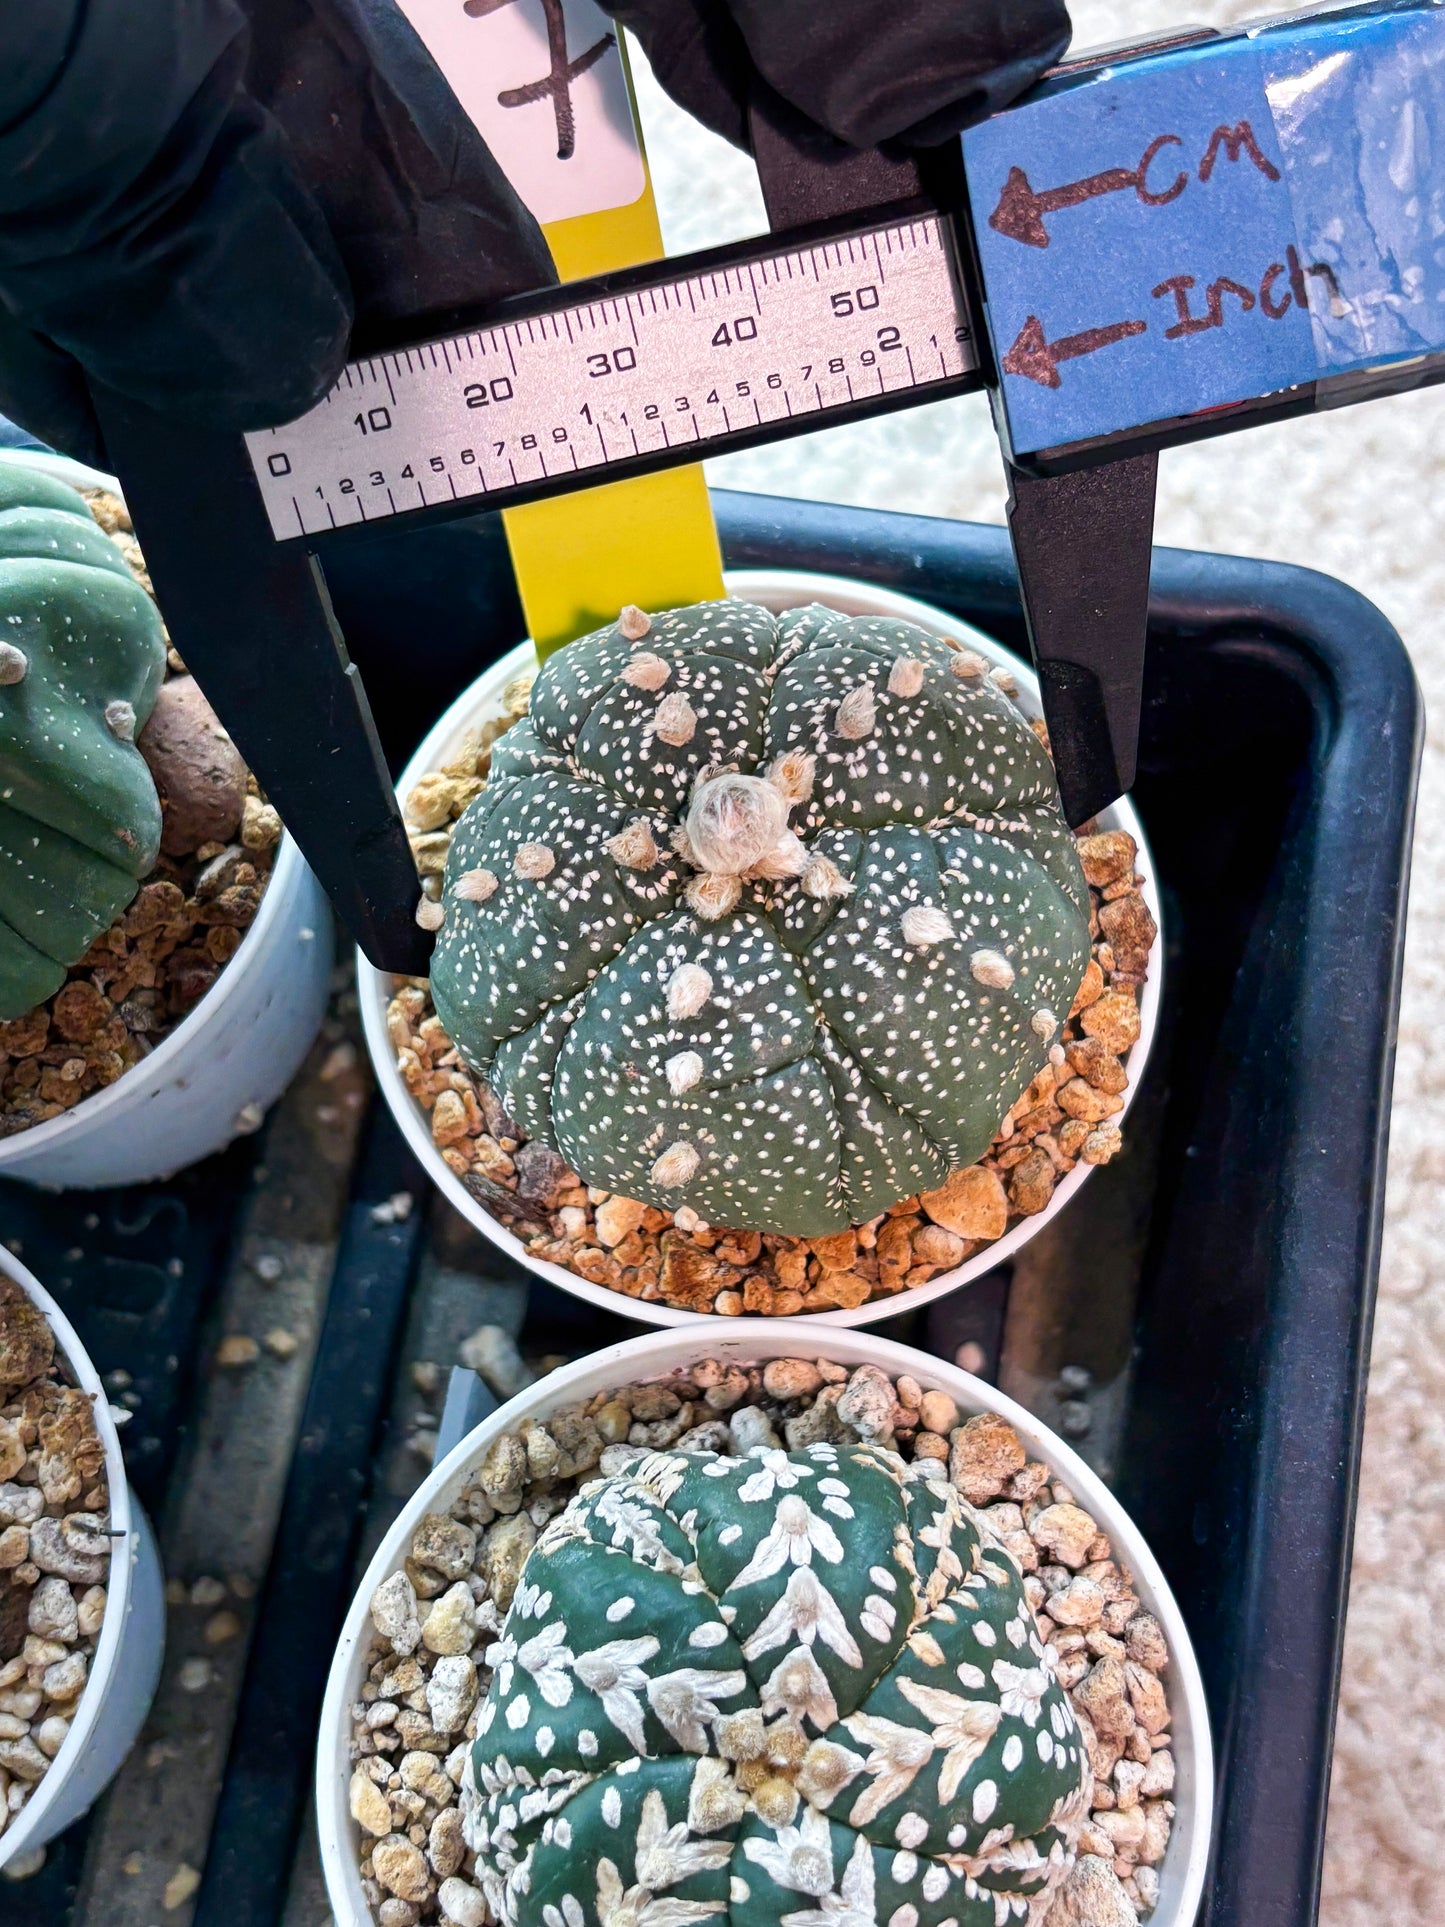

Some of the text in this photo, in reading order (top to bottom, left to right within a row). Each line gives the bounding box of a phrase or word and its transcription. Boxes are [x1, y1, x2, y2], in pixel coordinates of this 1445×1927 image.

[266, 285, 880, 478] 0 10 20 30 40 50
[315, 485, 325, 500] 1
[338, 478, 356, 495] 2
[368, 470, 386, 487] 3
[400, 463, 415, 479] 4
[429, 455, 446, 473] 5
[460, 448, 476, 466] 6
[492, 441, 506, 457] 7
[520, 433, 538, 451] 8
[551, 426, 569, 444] 9
[579, 402, 593, 426] 1
[619, 411, 629, 427] 1
[643, 404, 660, 421] 2
[674, 396, 691, 413] 3
[706, 388, 720, 404] 4
[735, 380, 751, 398] 5
[766, 372, 783, 390] 6
[800, 364, 813, 381] 7
[827, 357, 846, 375] 8
[859, 349, 876, 368] 9
[876, 326, 903, 353] 2
[929, 334, 938, 349] 1
